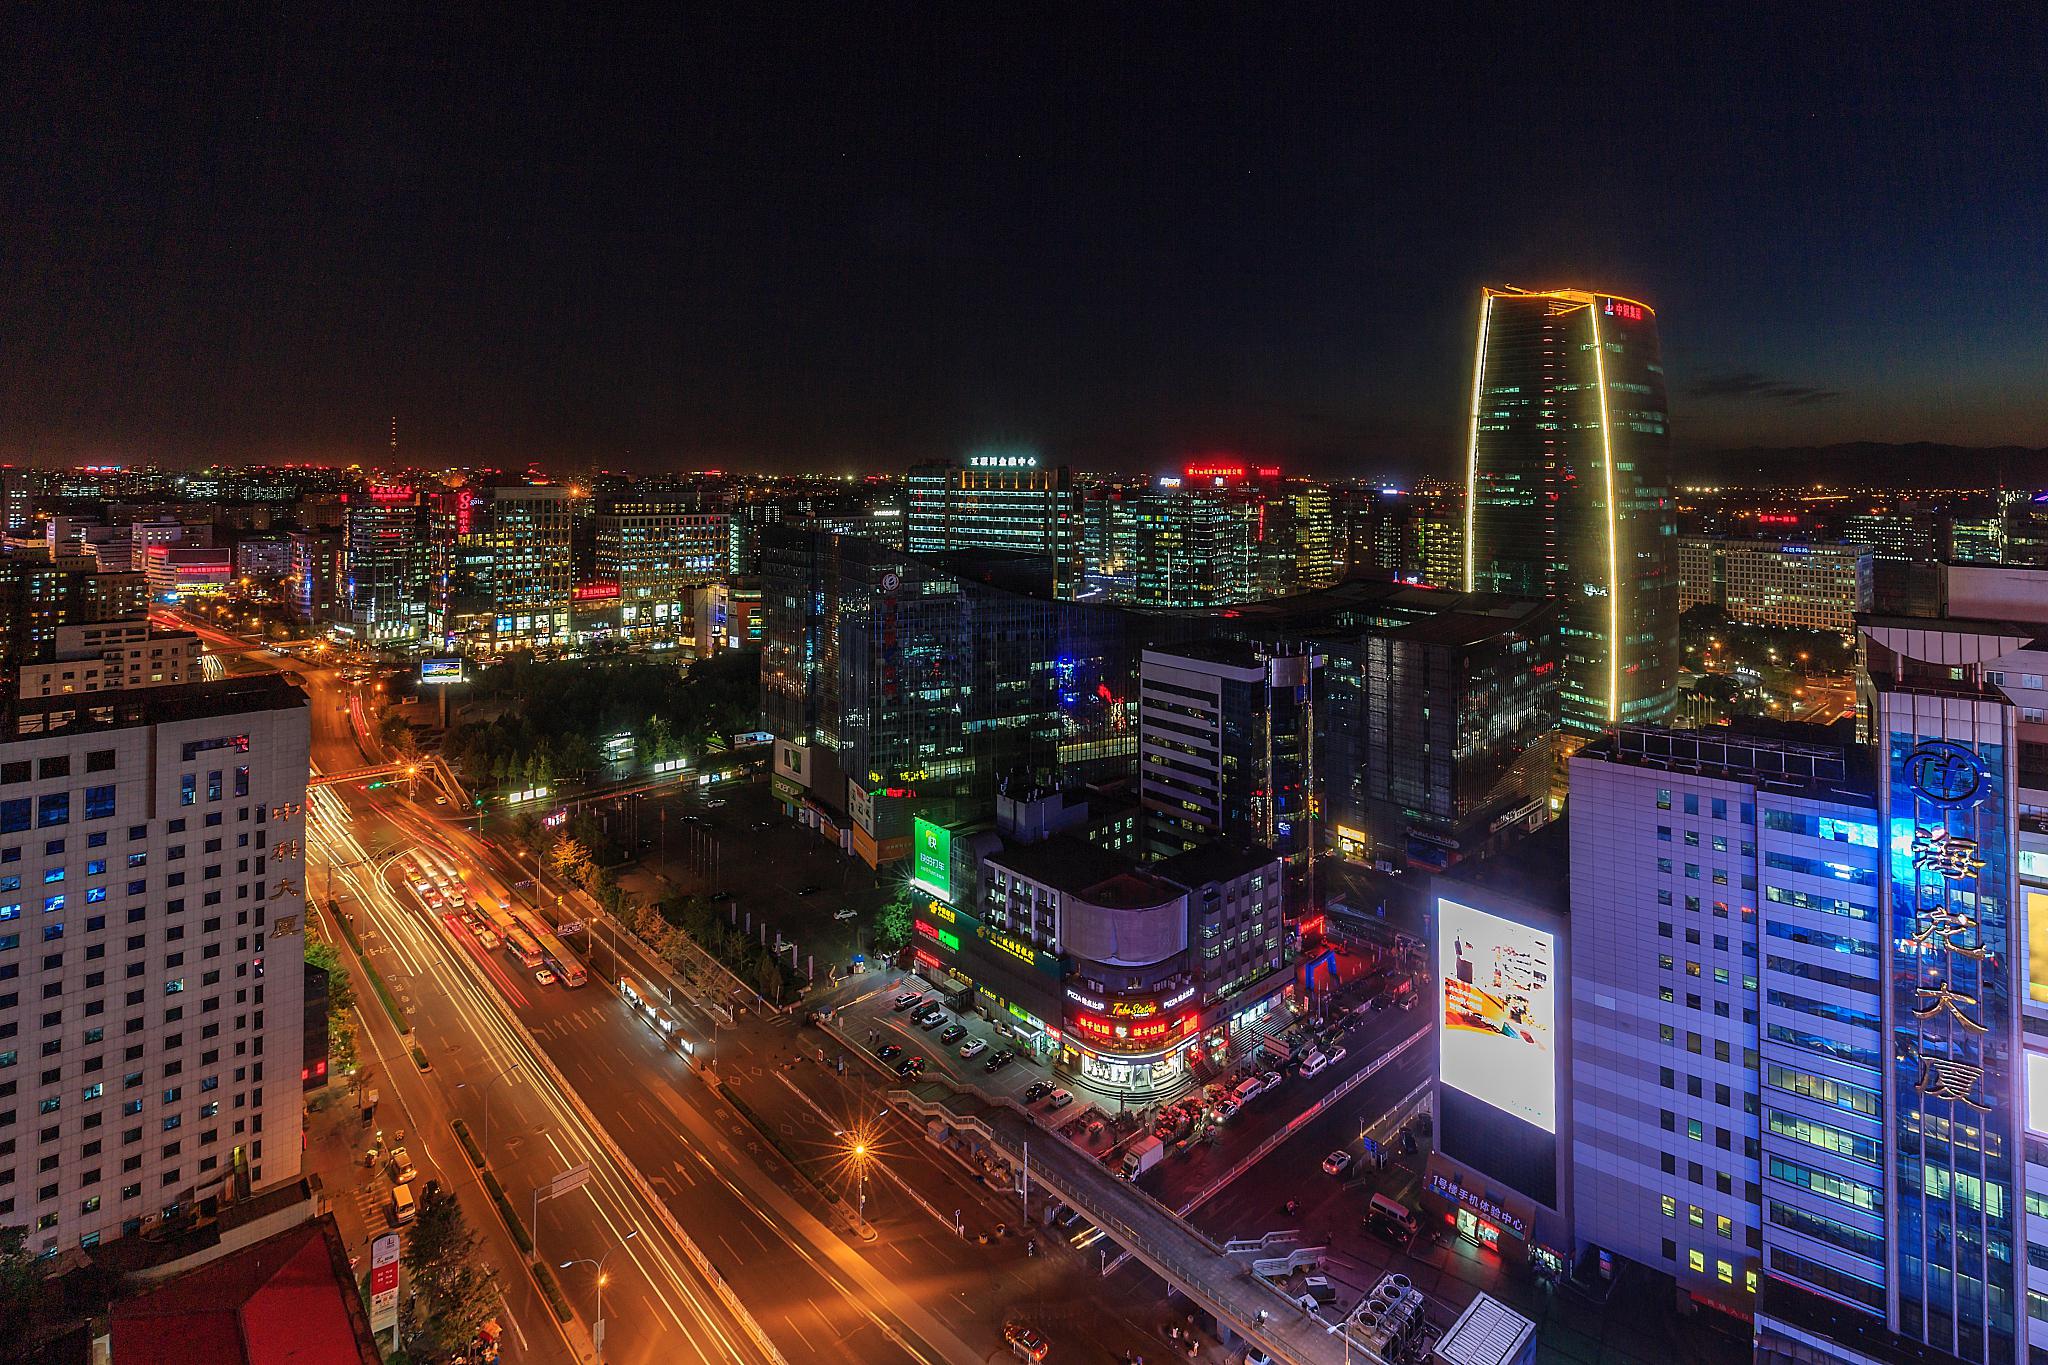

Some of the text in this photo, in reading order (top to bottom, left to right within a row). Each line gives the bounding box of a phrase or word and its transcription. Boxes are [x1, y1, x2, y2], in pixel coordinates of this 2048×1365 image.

[971, 457, 1037, 466] 互联网金融中心
[775, 780, 790, 793] acer
[269, 801, 302, 939] 中科大厦
[1067, 989, 1081, 1002] PIZZA
[1131, 1003, 1156, 1015] Station
[1163, 997, 1178, 1009] PIZZA
[1433, 1175, 1523, 1232] 1号楼手机体验中心
